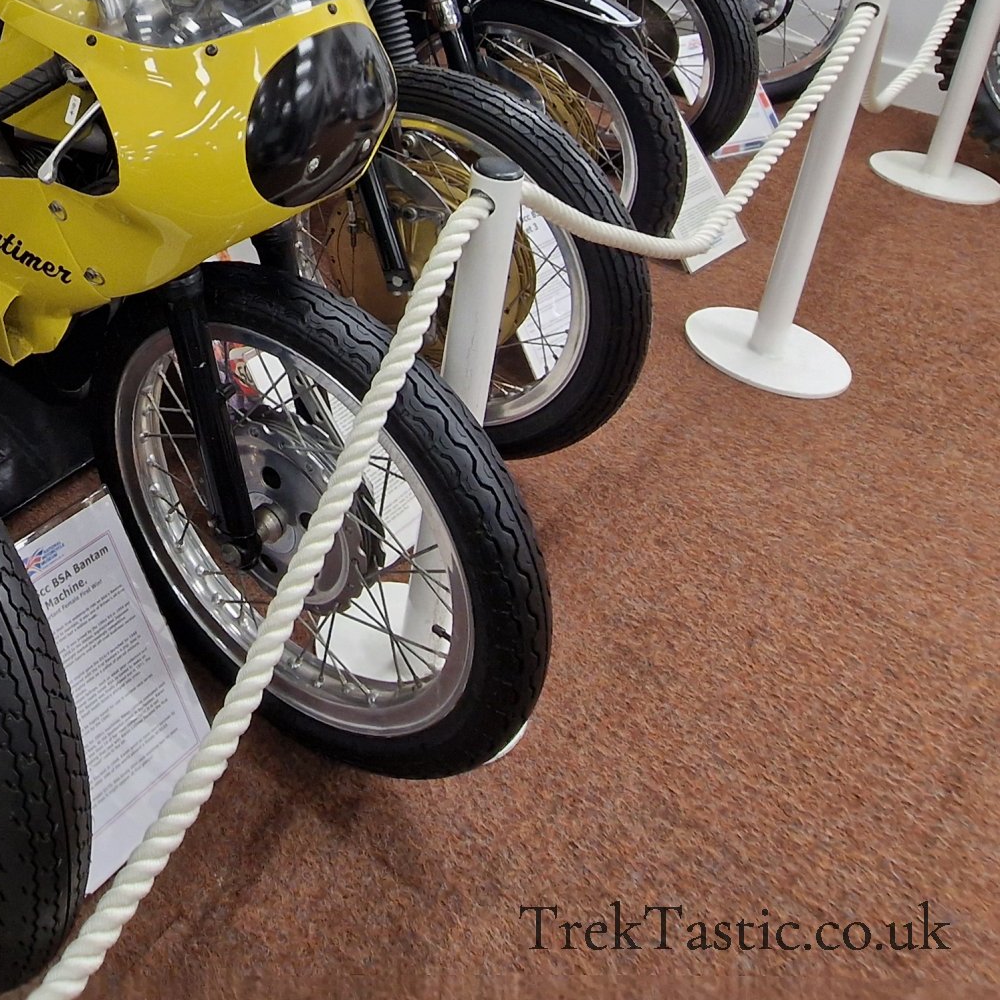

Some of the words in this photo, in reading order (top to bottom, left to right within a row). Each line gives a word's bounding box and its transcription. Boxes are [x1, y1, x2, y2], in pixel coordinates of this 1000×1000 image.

[51, 569, 73, 589] BSA
[72, 545, 109, 574] Bantam
[44, 579, 89, 611] Machine.
